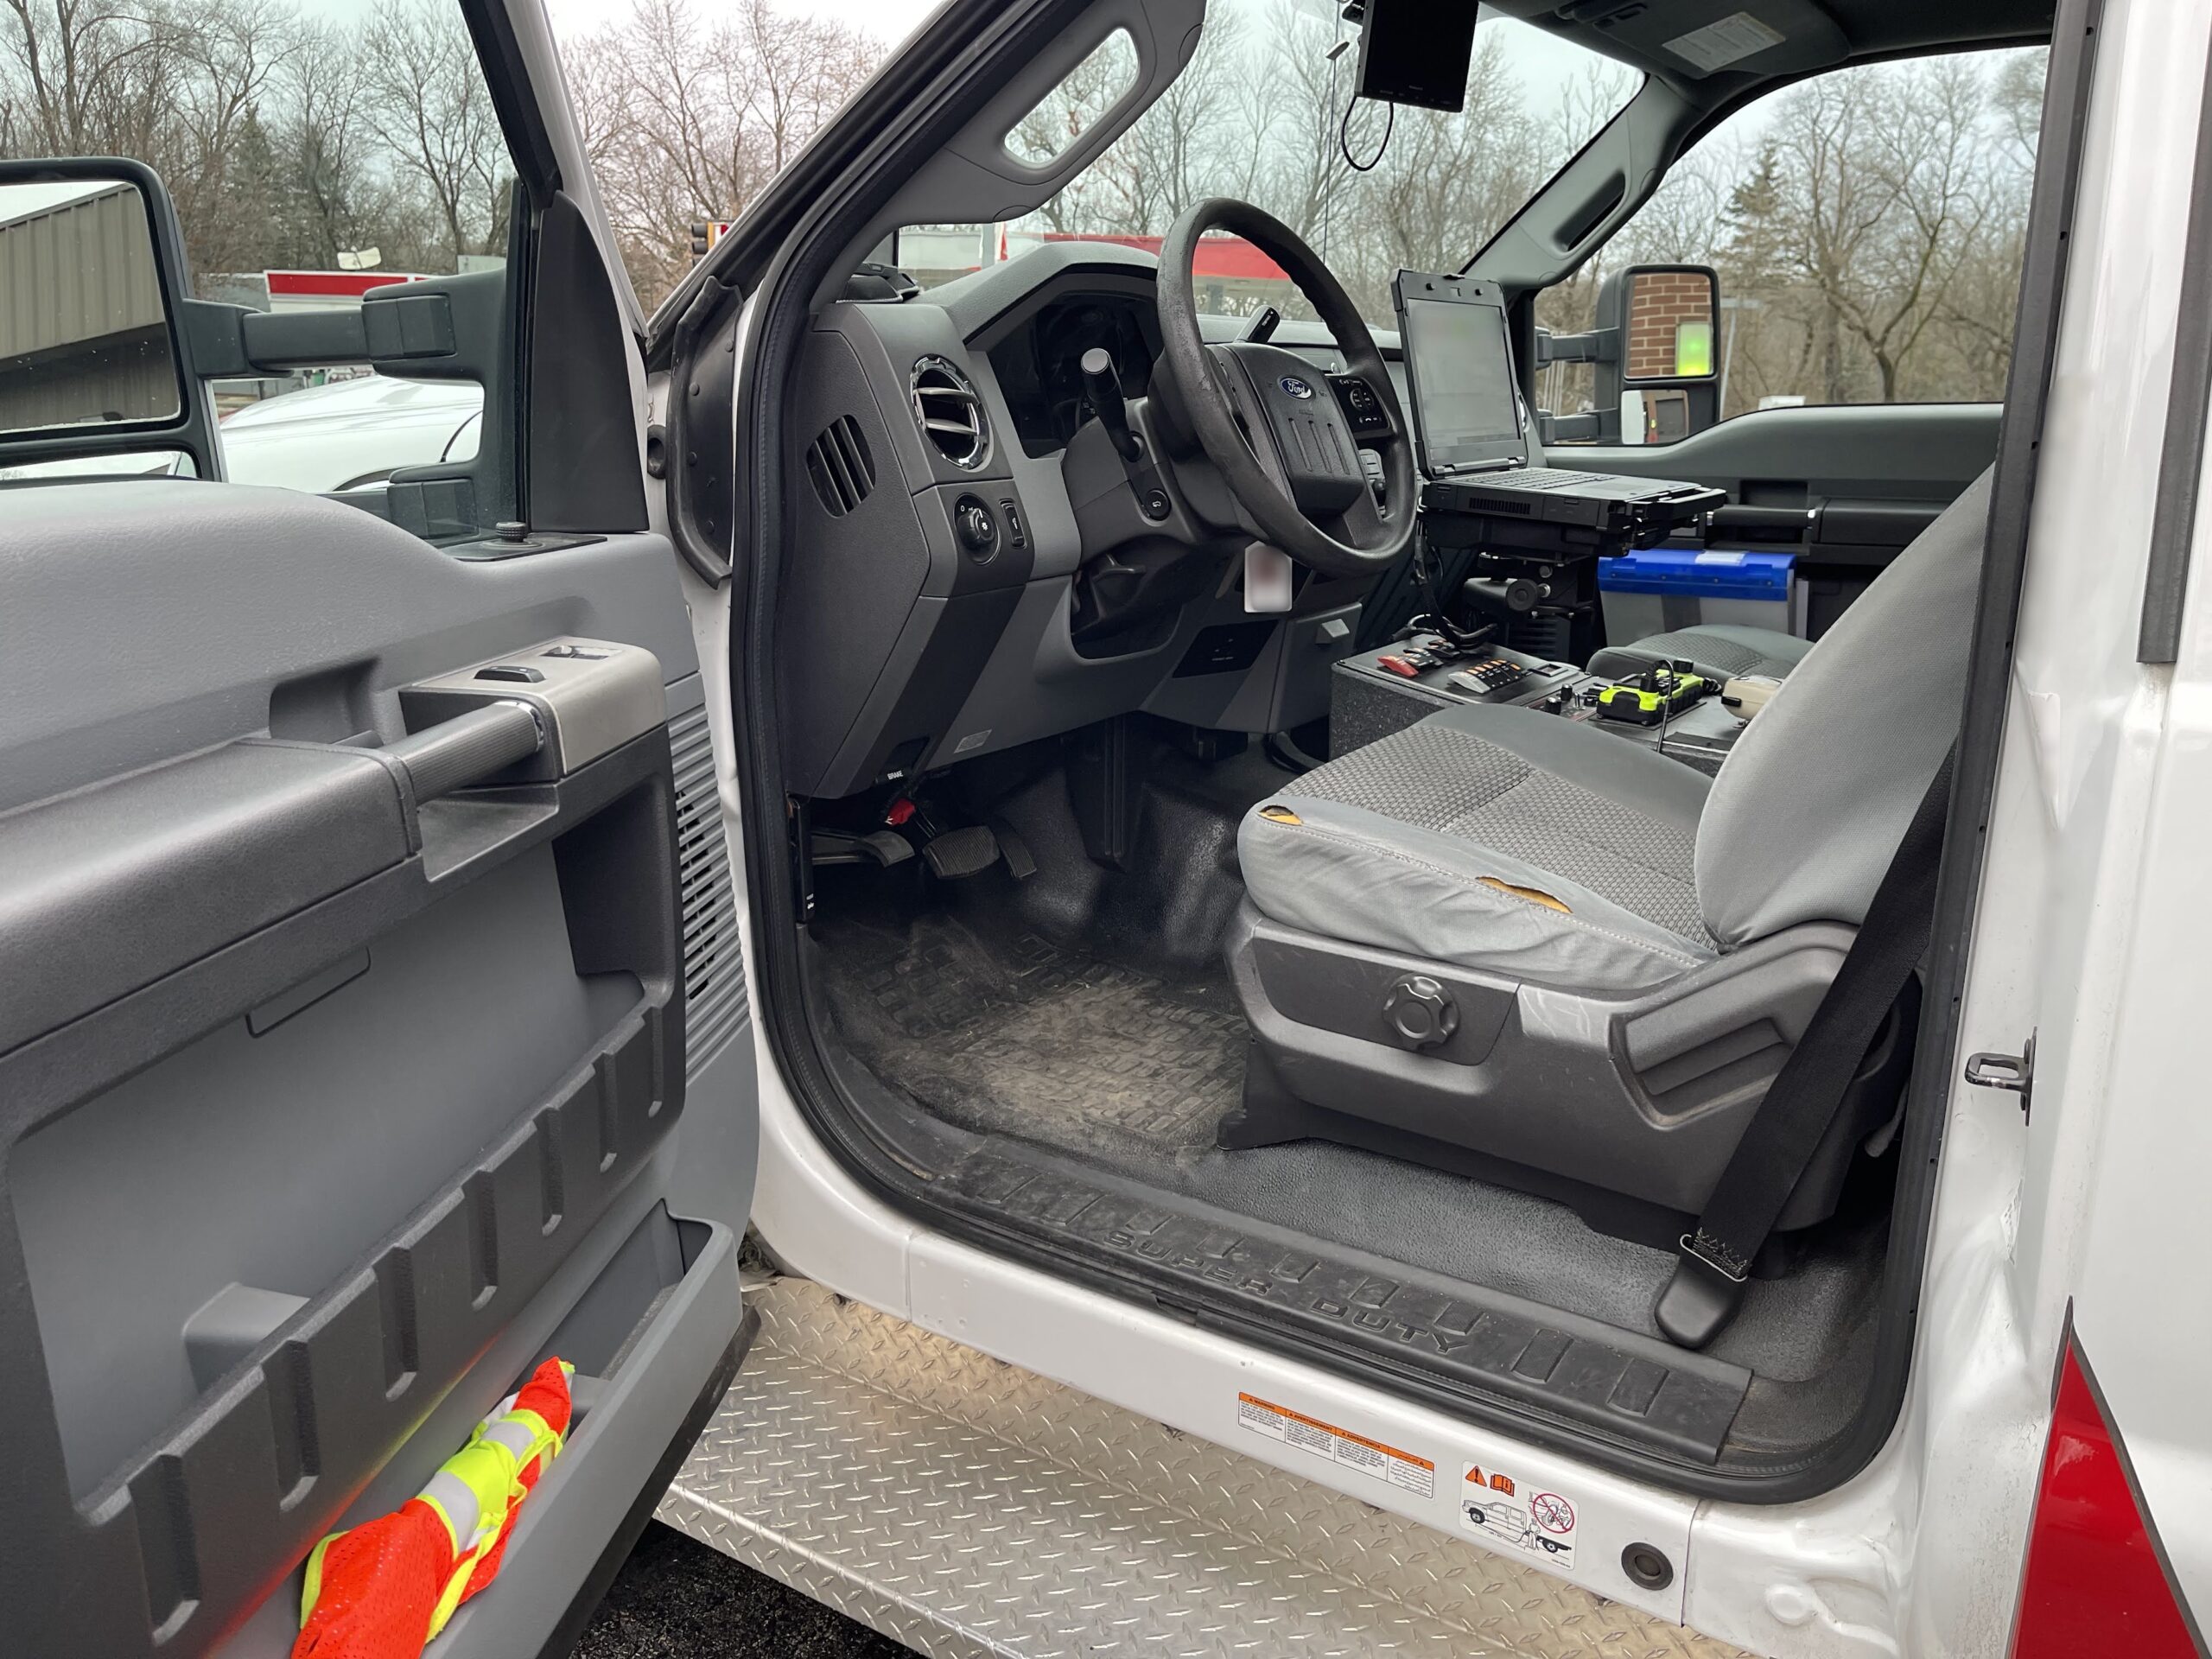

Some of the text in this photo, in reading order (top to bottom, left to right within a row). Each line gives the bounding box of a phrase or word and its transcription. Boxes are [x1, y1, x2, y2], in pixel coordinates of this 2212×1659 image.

[887, 770, 904, 780] BRAKE
[1103, 1230, 1470, 1355] SUPER DUTY
